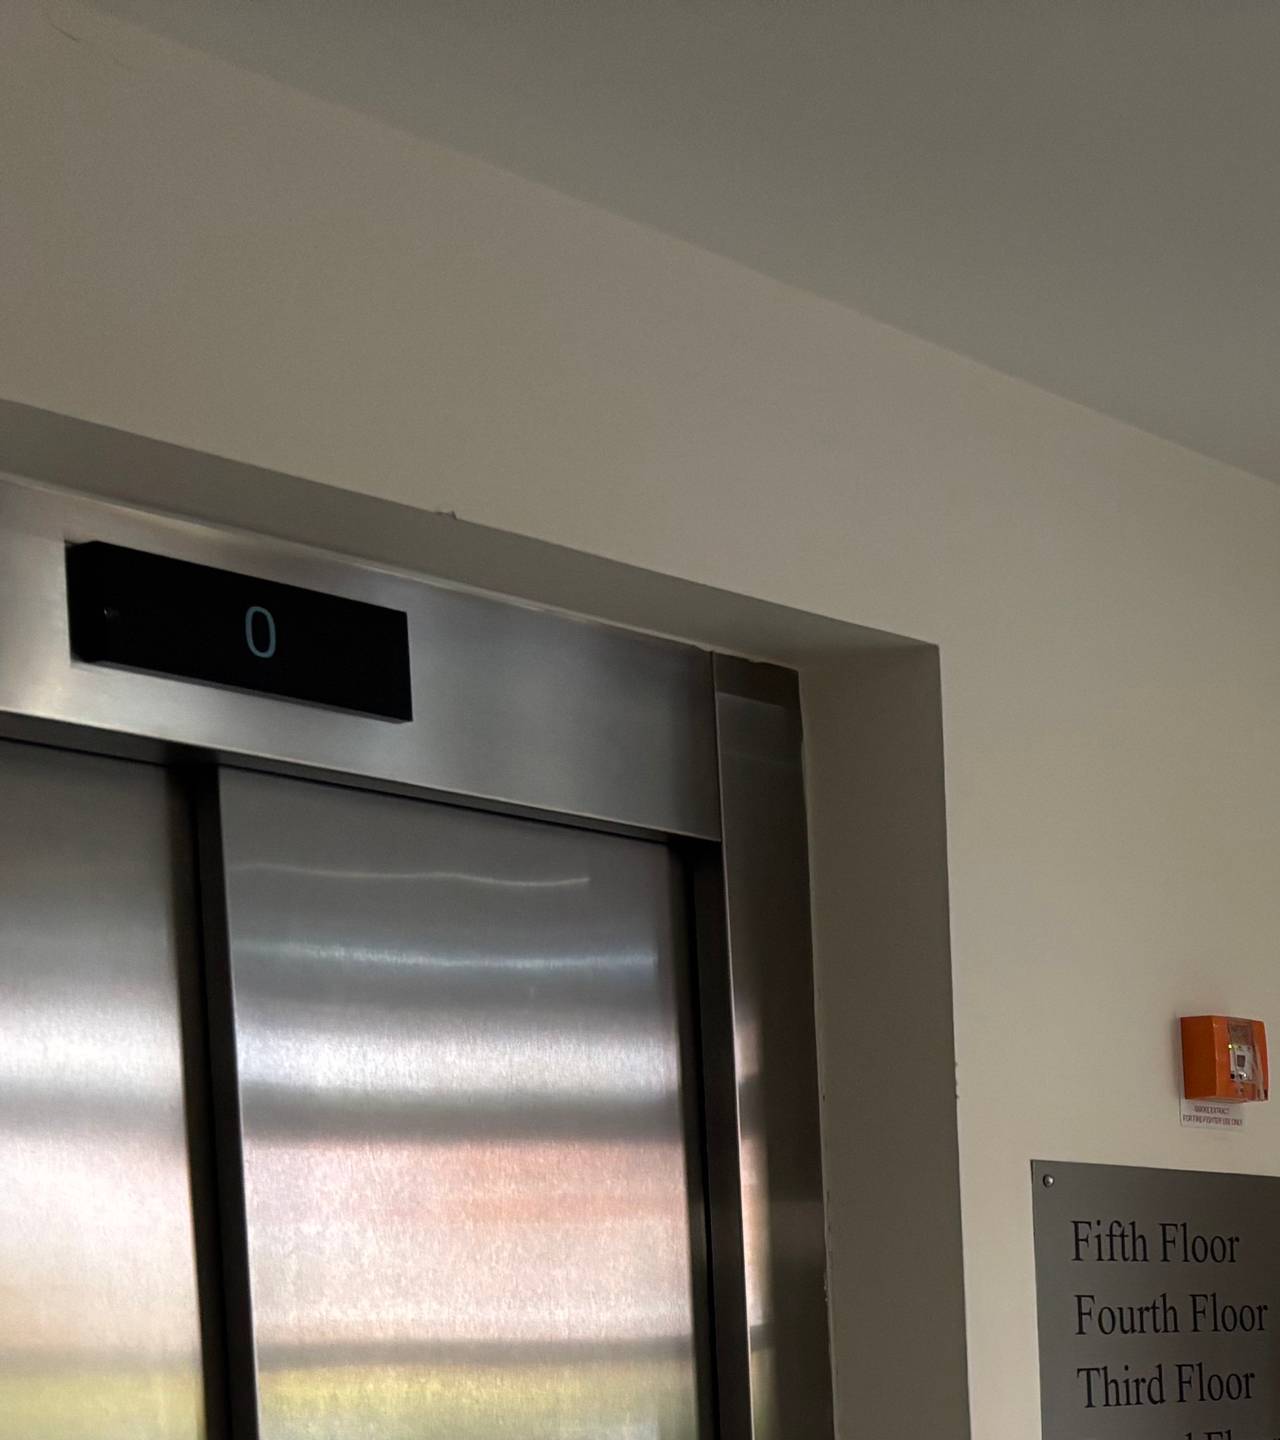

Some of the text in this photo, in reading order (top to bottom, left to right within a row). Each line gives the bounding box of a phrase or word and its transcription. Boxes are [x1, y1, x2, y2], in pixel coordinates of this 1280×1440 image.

[245, 606, 276, 659] 0
[1071, 1219, 1150, 1263] Fifth
[1159, 1222, 1240, 1264] Floor
[1075, 1292, 1181, 1335] Fourth
[1188, 1292, 1269, 1333] Floor
[1076, 1363, 1167, 1409] Third
[1175, 1361, 1256, 1403] Floor
